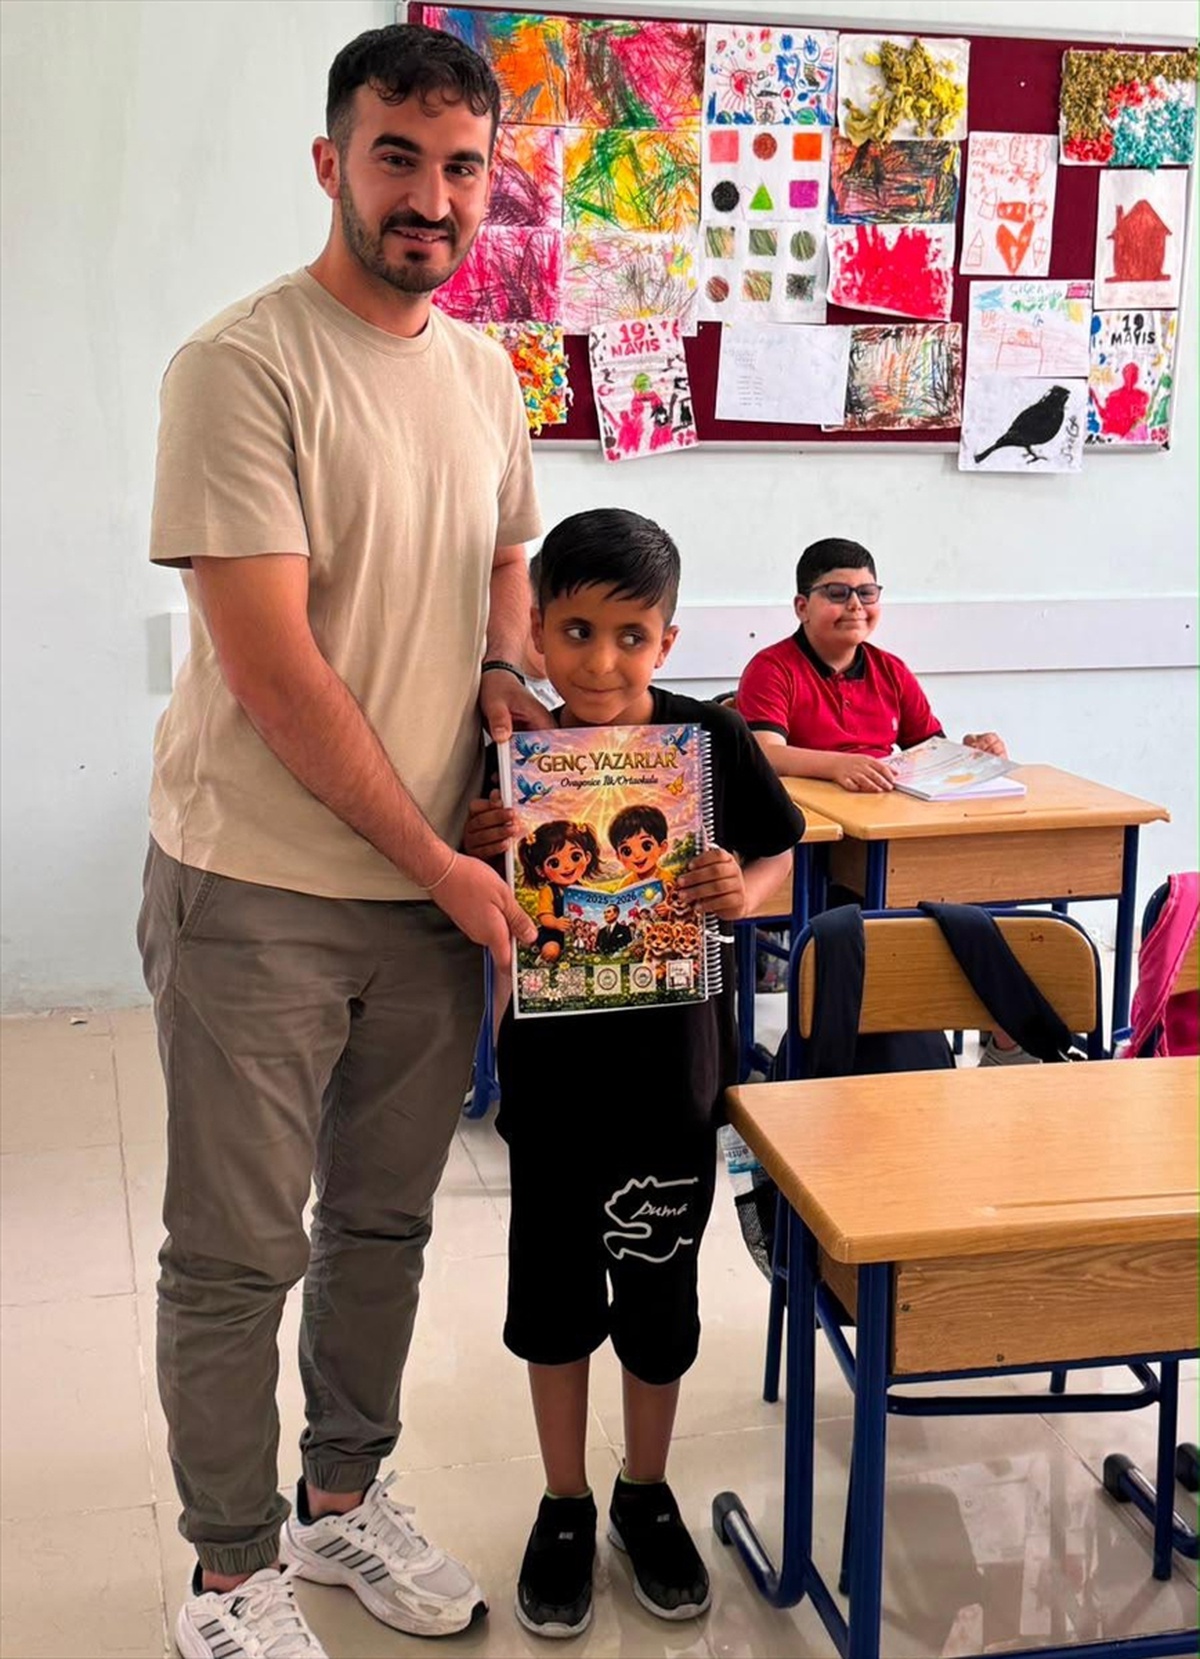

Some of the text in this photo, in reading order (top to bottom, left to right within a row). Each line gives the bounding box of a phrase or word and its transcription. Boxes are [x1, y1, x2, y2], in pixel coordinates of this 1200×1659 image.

[619, 322, 645, 343] 19
[1122, 313, 1144, 333] 19
[1111, 331, 1155, 346] MAYIS
[537, 752, 678, 775] GENÇ YAZARLAR
[586, 894, 608, 904] 2025
[616, 892, 637, 904] 2026
